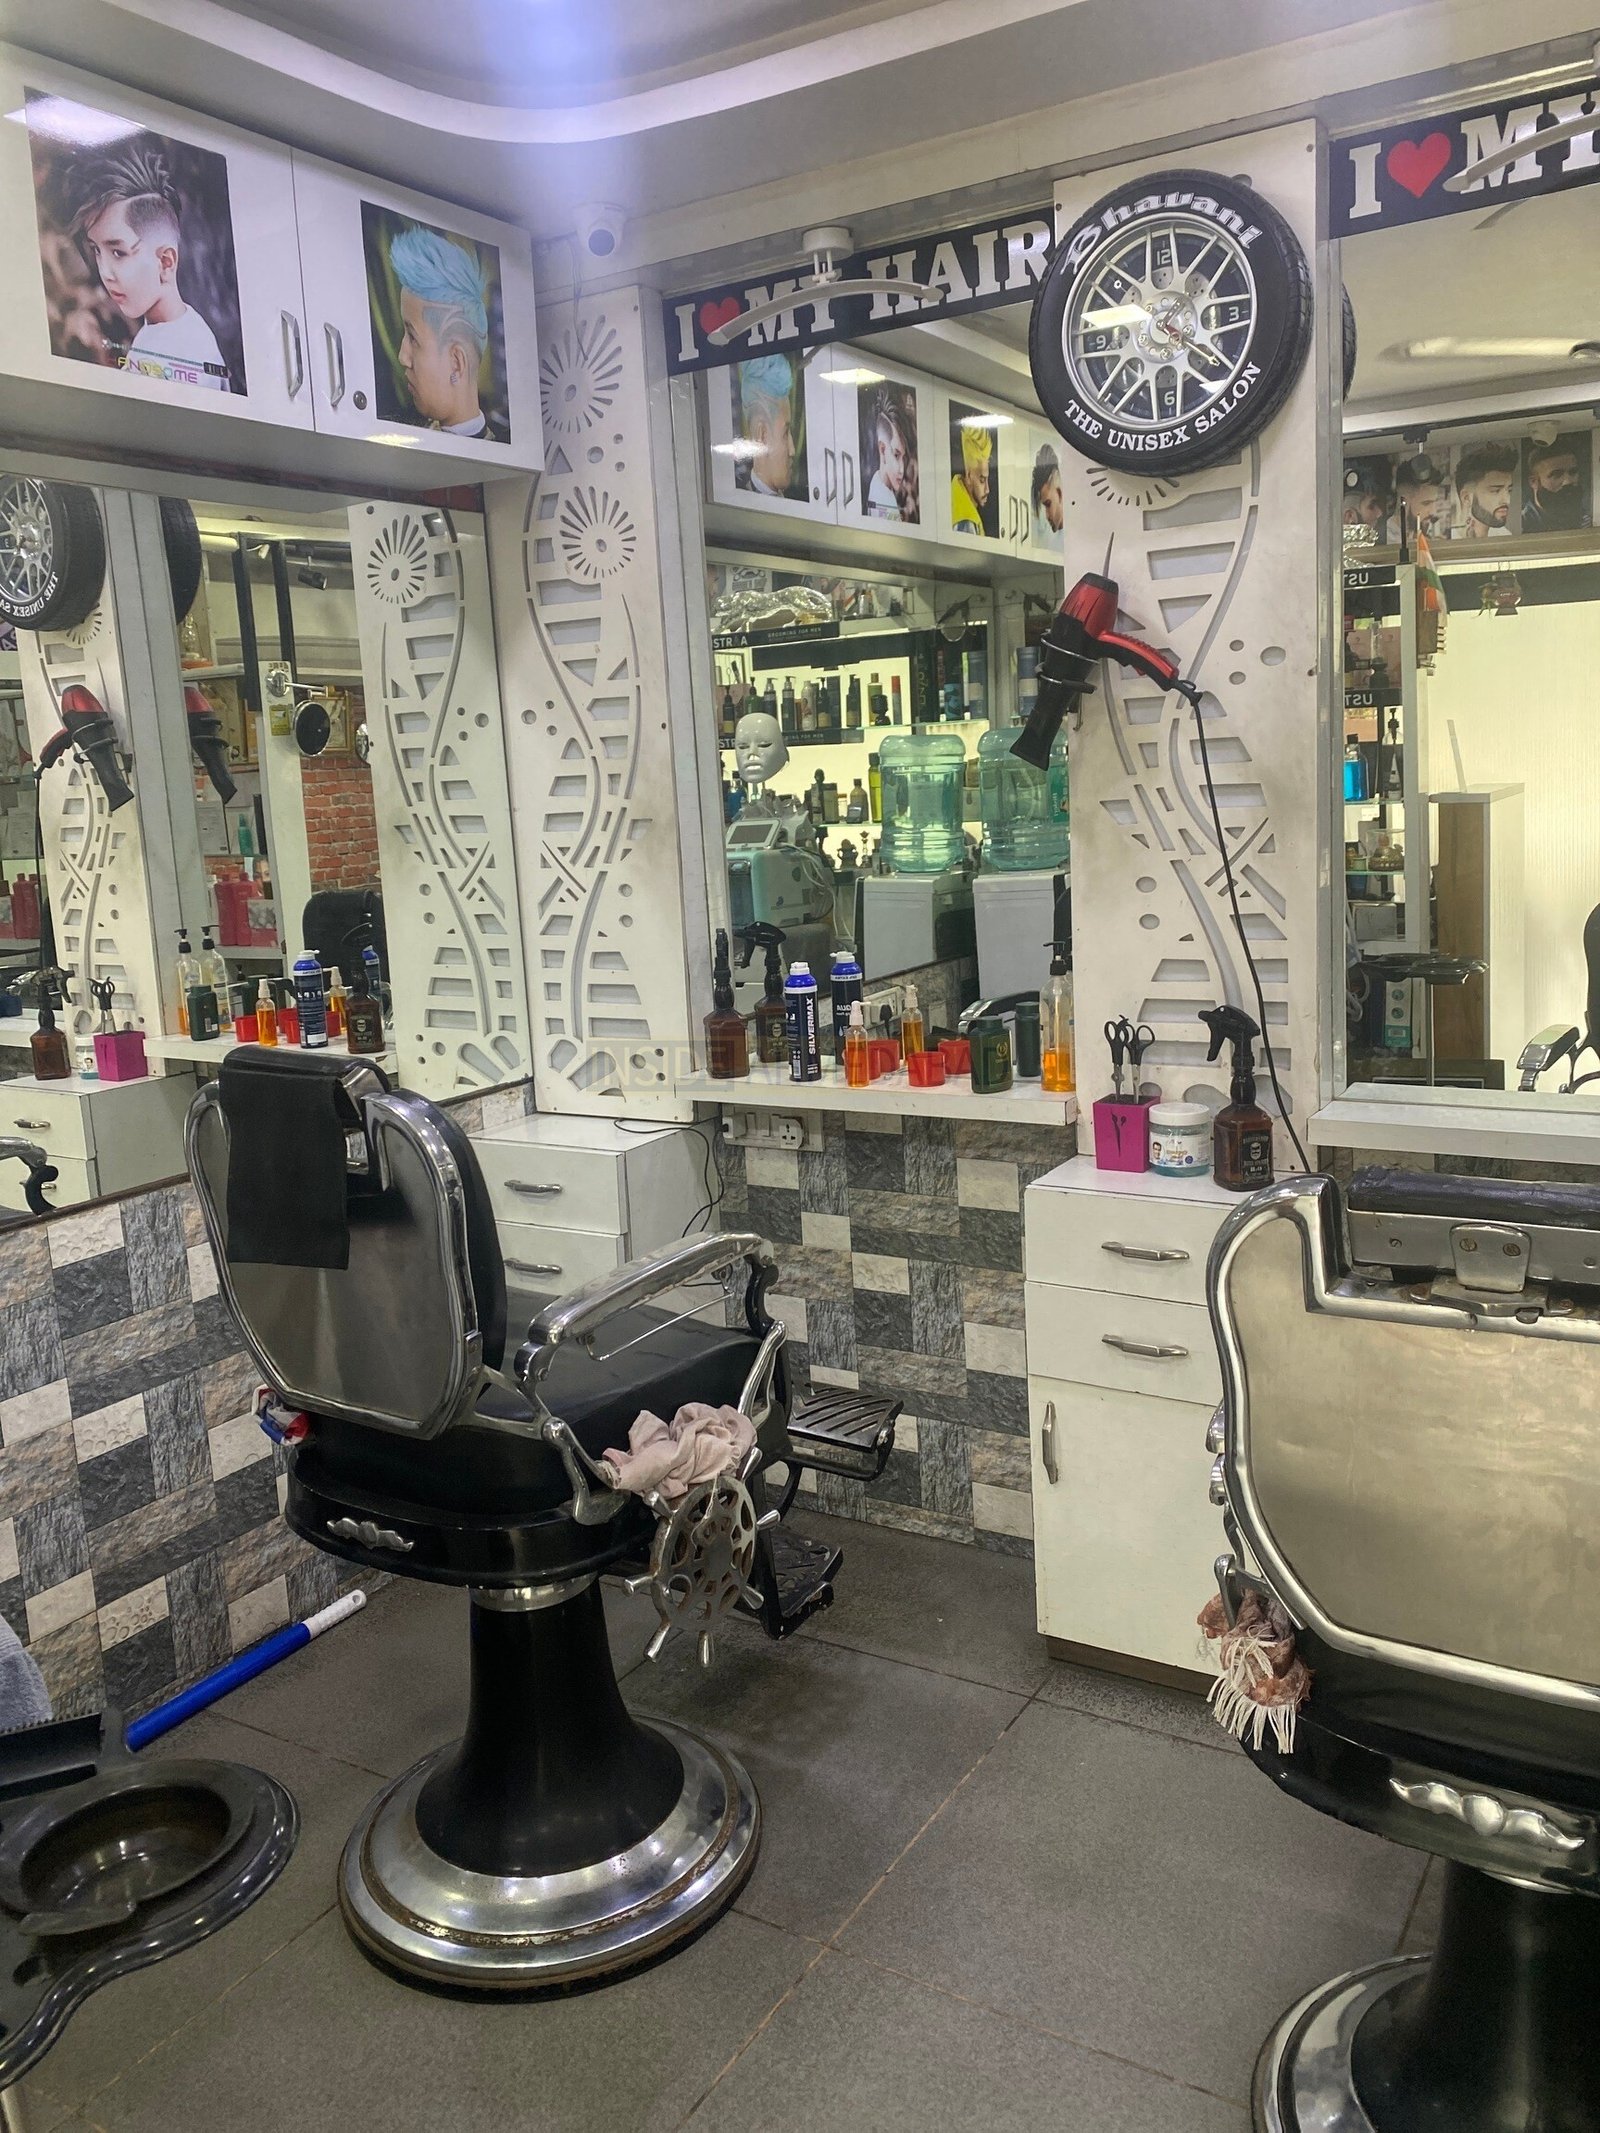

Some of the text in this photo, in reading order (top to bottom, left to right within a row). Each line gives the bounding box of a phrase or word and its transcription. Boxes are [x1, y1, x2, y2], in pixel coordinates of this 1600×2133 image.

[1349, 90, 1600, 219] I MY
[1060, 191, 1263, 275] Bhavani
[1157, 250, 1172, 265] 12
[675, 220, 1051, 362] I MY HAIR
[1229, 306, 1240, 321] 3
[1095, 335, 1106, 349] 9
[1064, 361, 1263, 451] THE UNISEX SALON
[1164, 391, 1175, 405] 6
[806, 998, 816, 1054] SILVERMAX
